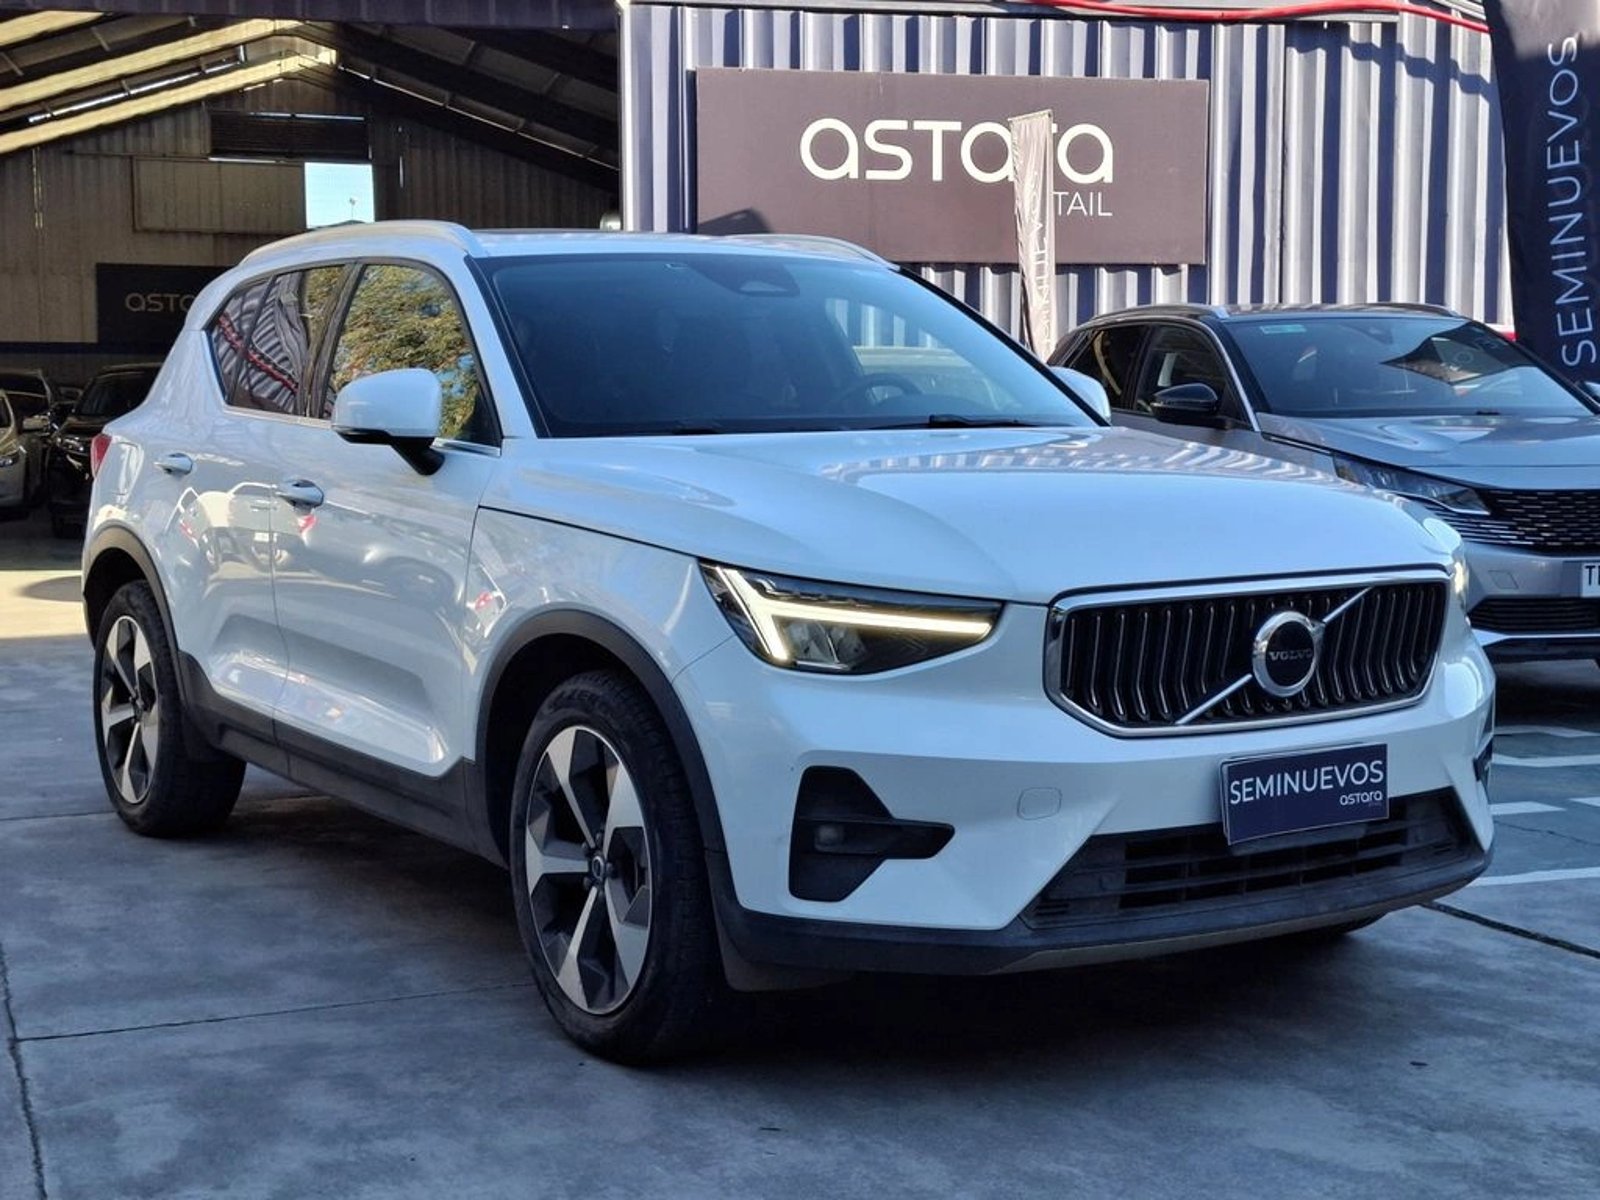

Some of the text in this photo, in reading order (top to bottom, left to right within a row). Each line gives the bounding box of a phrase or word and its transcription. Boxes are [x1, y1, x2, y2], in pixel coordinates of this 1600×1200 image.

[800, 117, 1114, 185] astaa
[1052, 190, 1113, 217] TAIL
[1547, 36, 1597, 367] SEMINUEVOS
[1268, 648, 1313, 661] VOLVO
[1229, 760, 1385, 806] SEMINUEVOS
